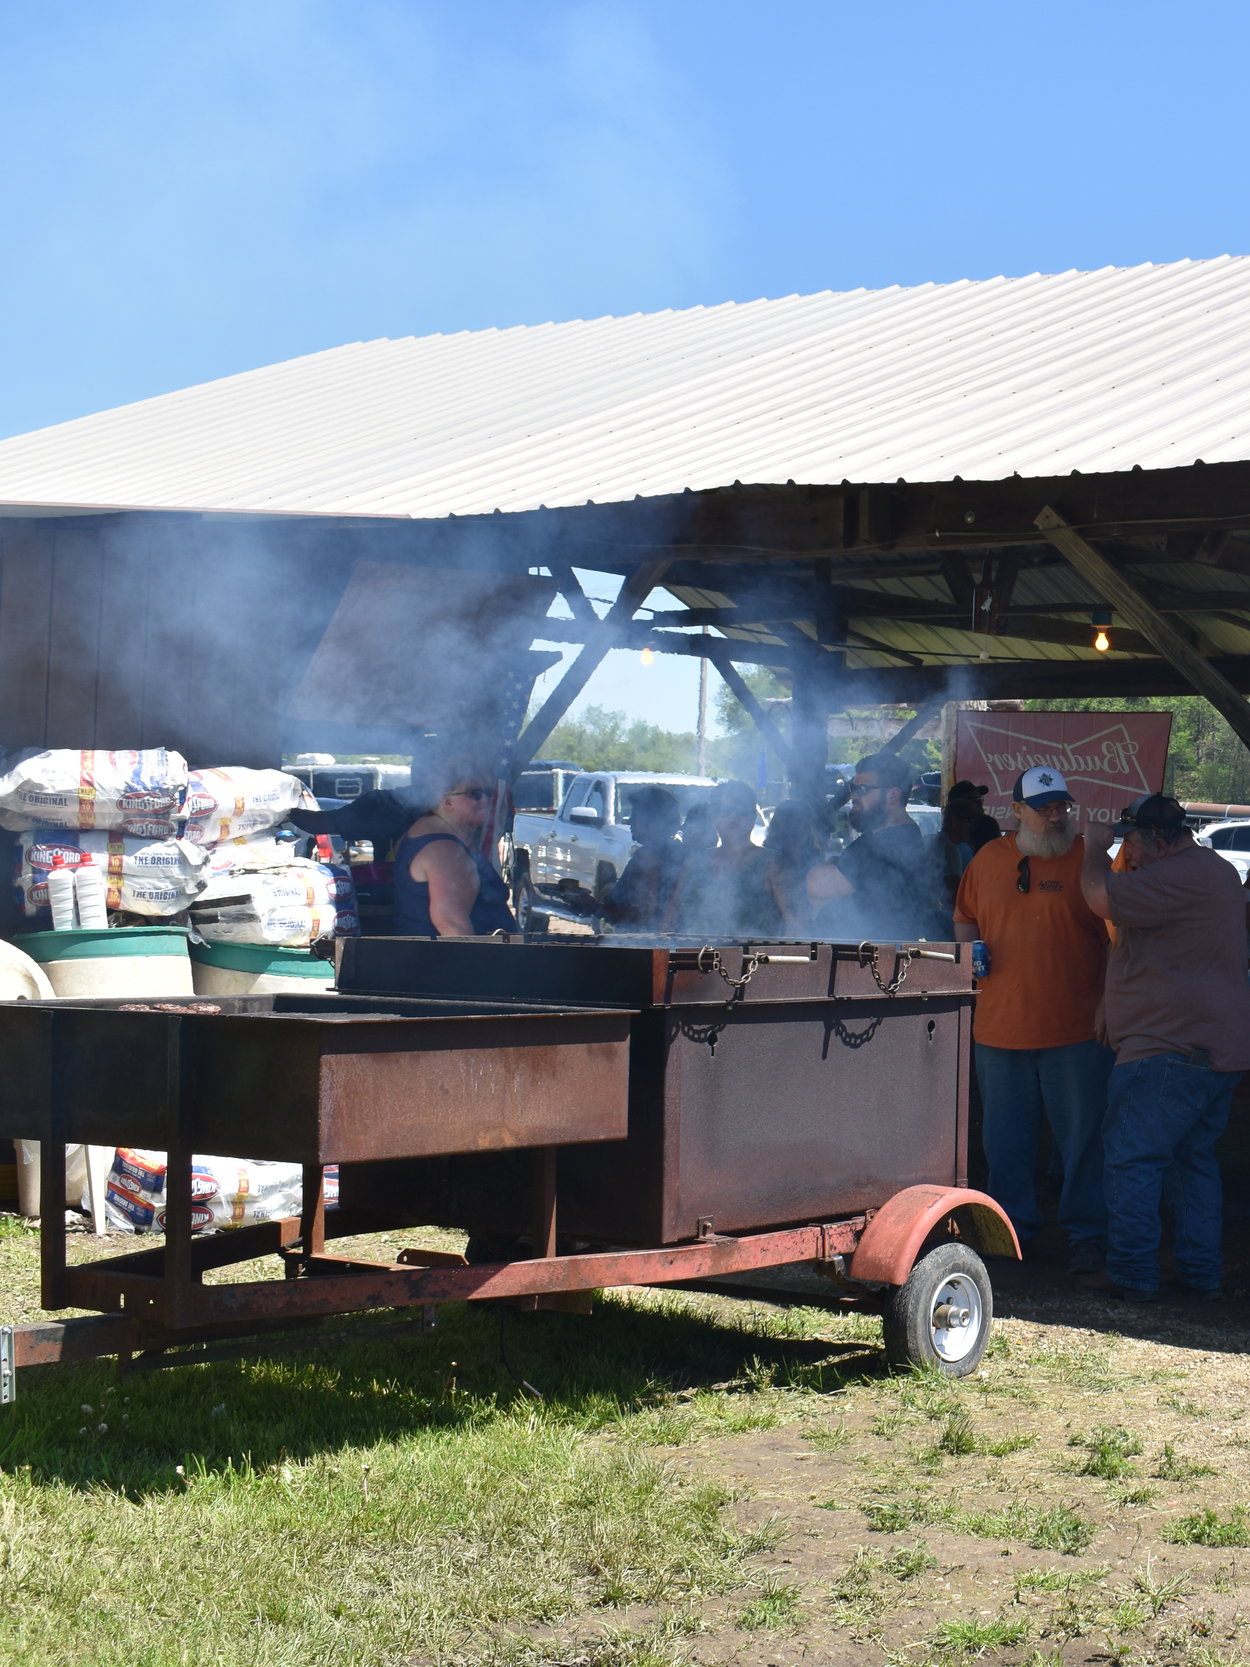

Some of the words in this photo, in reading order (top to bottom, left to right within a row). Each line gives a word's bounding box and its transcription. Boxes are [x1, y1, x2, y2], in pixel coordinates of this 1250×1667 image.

[29, 795, 69, 807] ORIGINAL
[134, 855, 148, 865] THE
[150, 856, 181, 866] ORIGIN
[133, 890, 147, 899] THE
[148, 891, 179, 901] ORIGIN
[191, 1178, 216, 1195] KINGS
